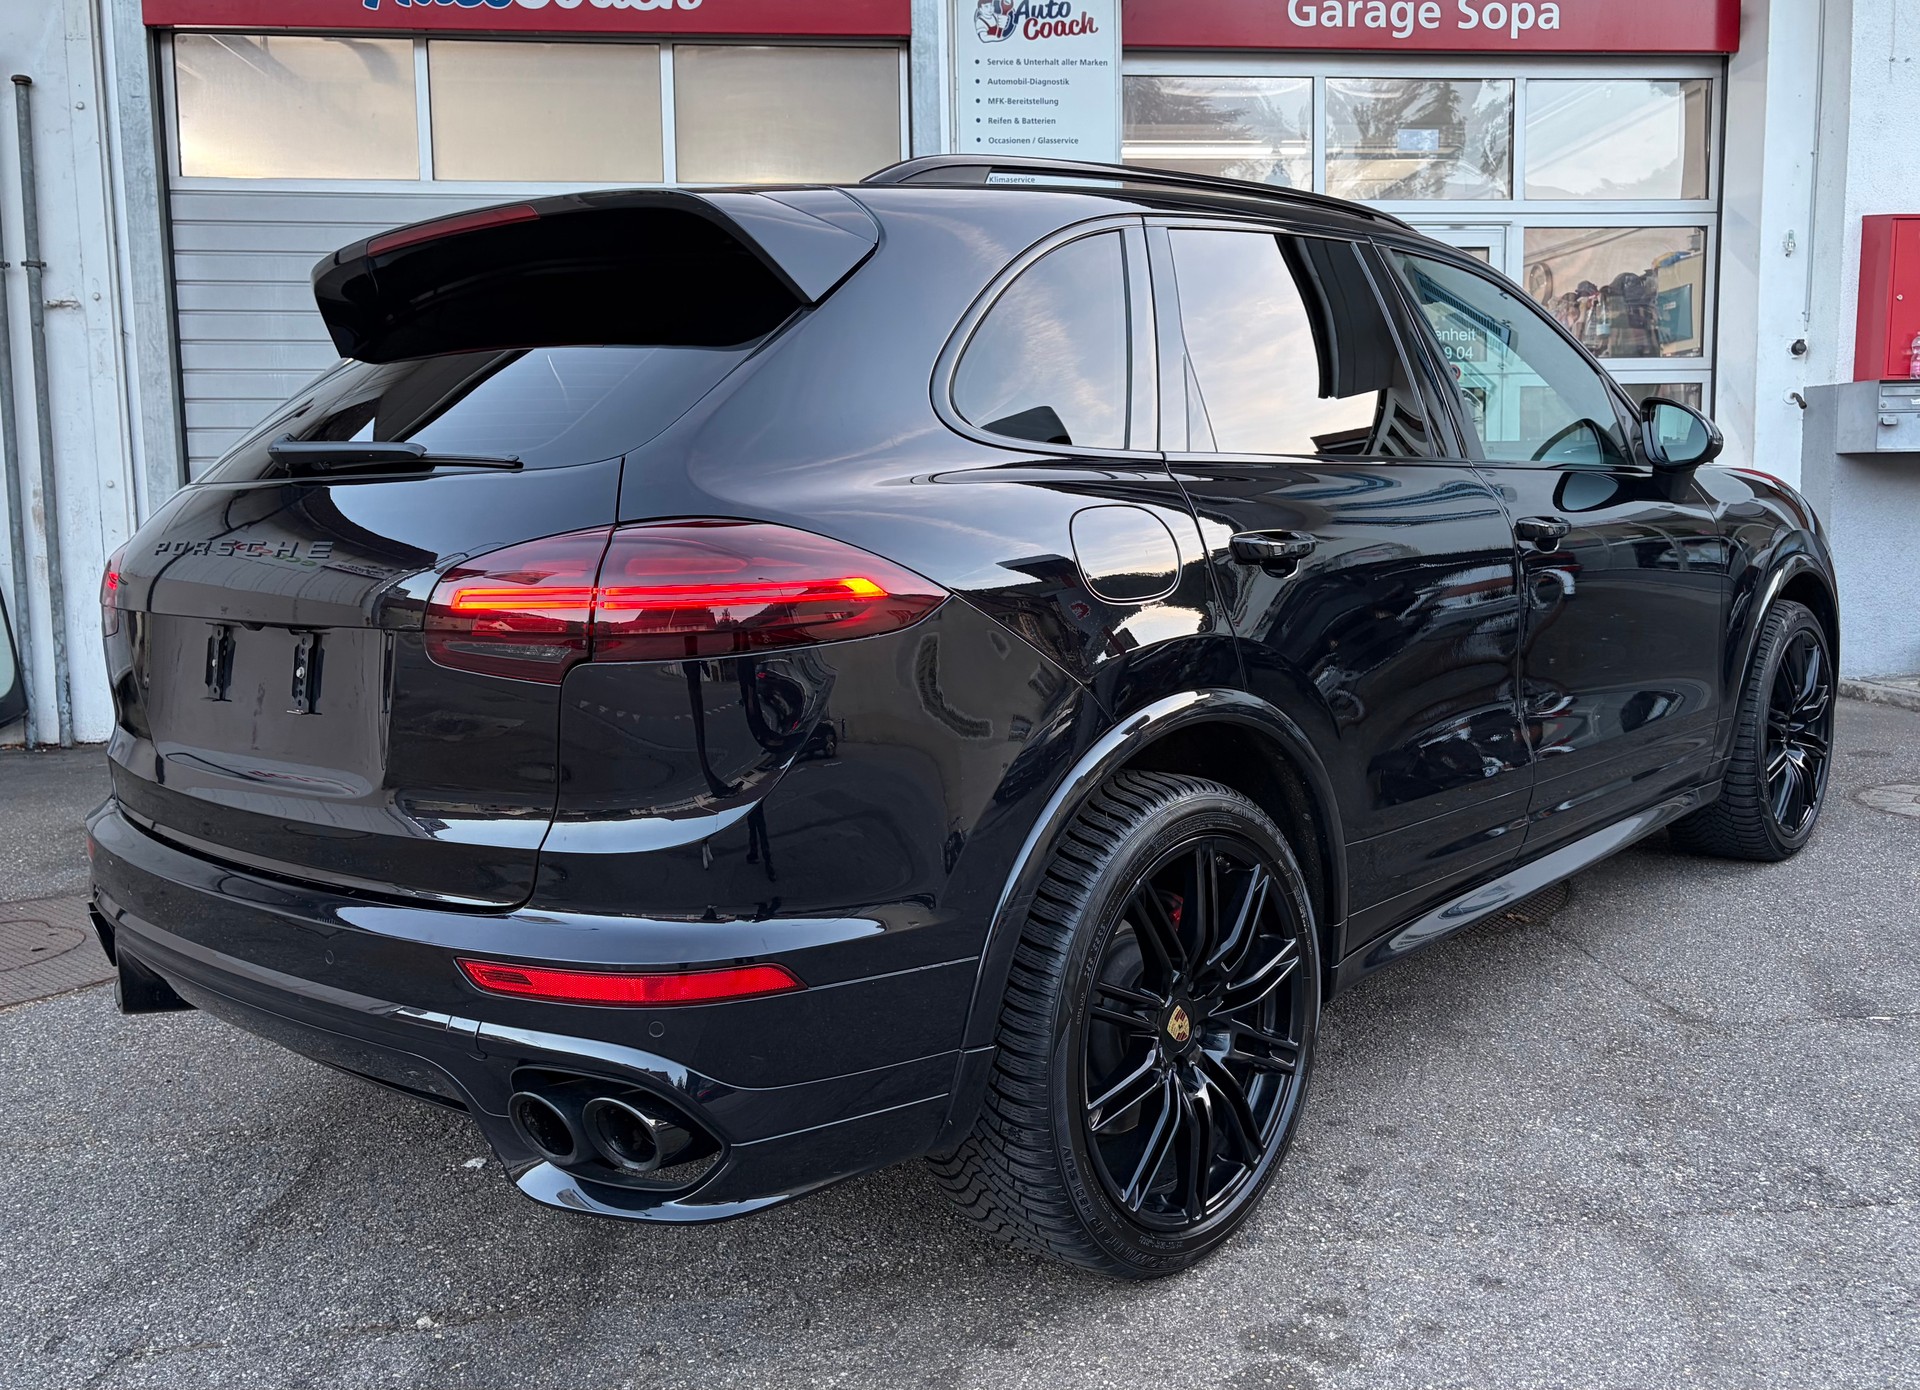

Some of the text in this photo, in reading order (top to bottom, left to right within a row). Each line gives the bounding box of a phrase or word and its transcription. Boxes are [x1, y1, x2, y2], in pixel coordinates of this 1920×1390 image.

[1014, 0, 1071, 24] Auto
[1287, 0, 1560, 39] Garage Sopa
[1023, 11, 1099, 40] Coach
[987, 58, 1108, 67] Service & Unterhalt aller Marken
[987, 77, 1070, 88] Automobil-Diagnostik
[987, 97, 1059, 107] MFK-Bereitstellung
[987, 117, 1057, 125] Reifen & Batterien
[988, 136, 1031, 145] Occasionen
[1037, 136, 1079, 145] Glasservice
[988, 176, 1036, 184] Klimaservice
[1456, 346, 1474, 360] 04
[154, 540, 335, 560] PORSCHE
